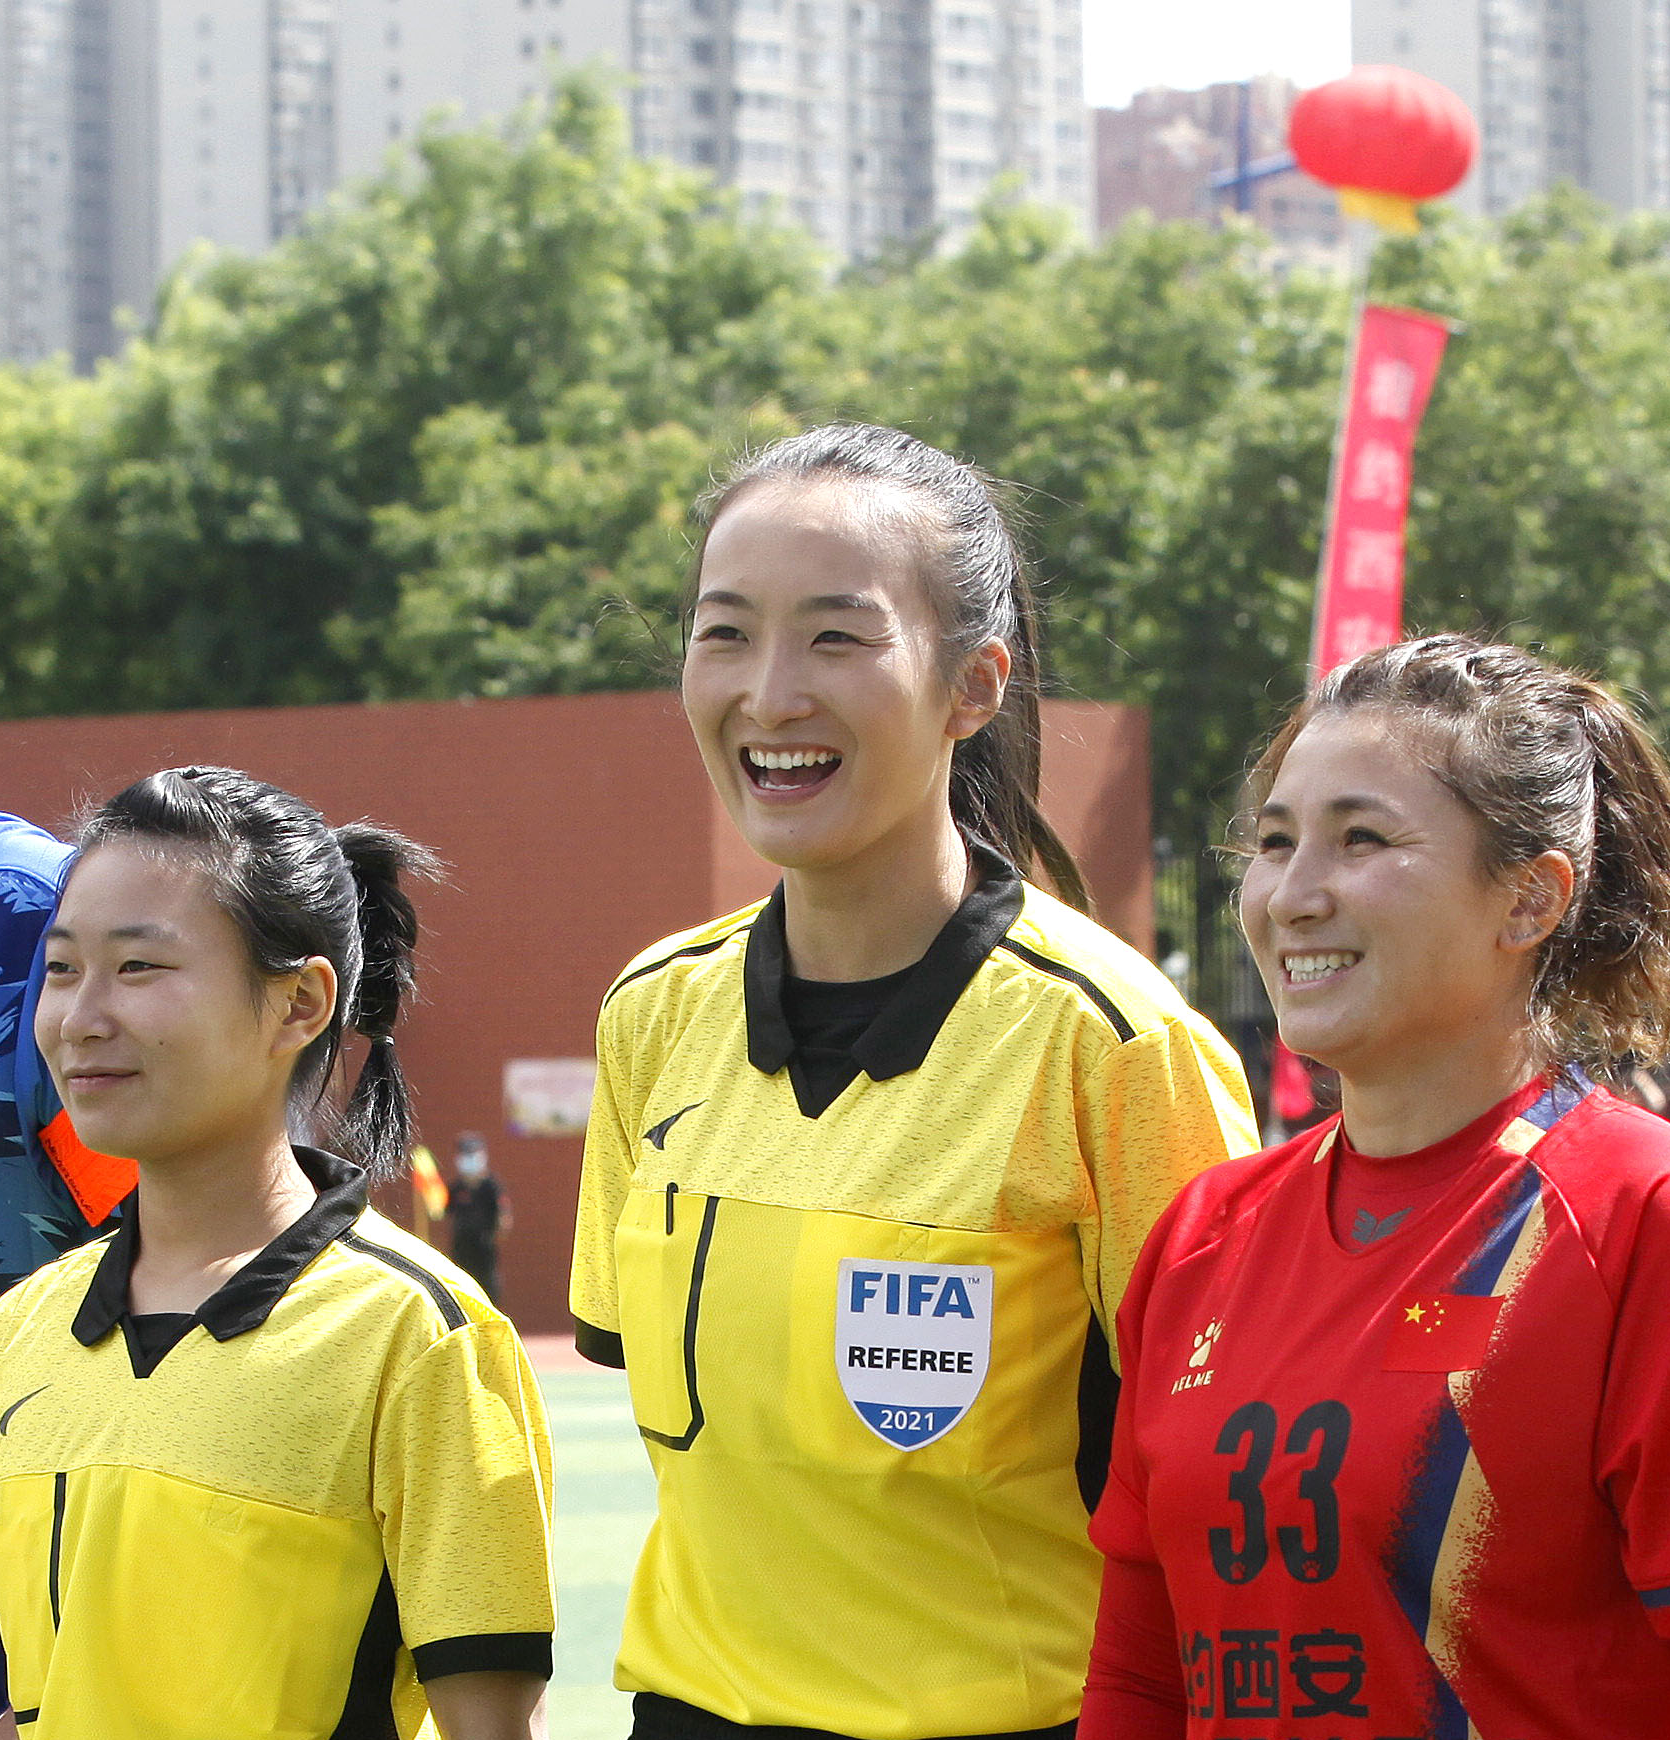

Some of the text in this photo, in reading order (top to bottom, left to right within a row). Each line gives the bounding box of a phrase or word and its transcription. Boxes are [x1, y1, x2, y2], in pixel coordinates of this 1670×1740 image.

[850, 1271, 975, 1319] FIFA
[848, 1346, 973, 1374] REFEREE
[879, 1409, 935, 1431] 2021
[1209, 1400, 1351, 1585] 33
